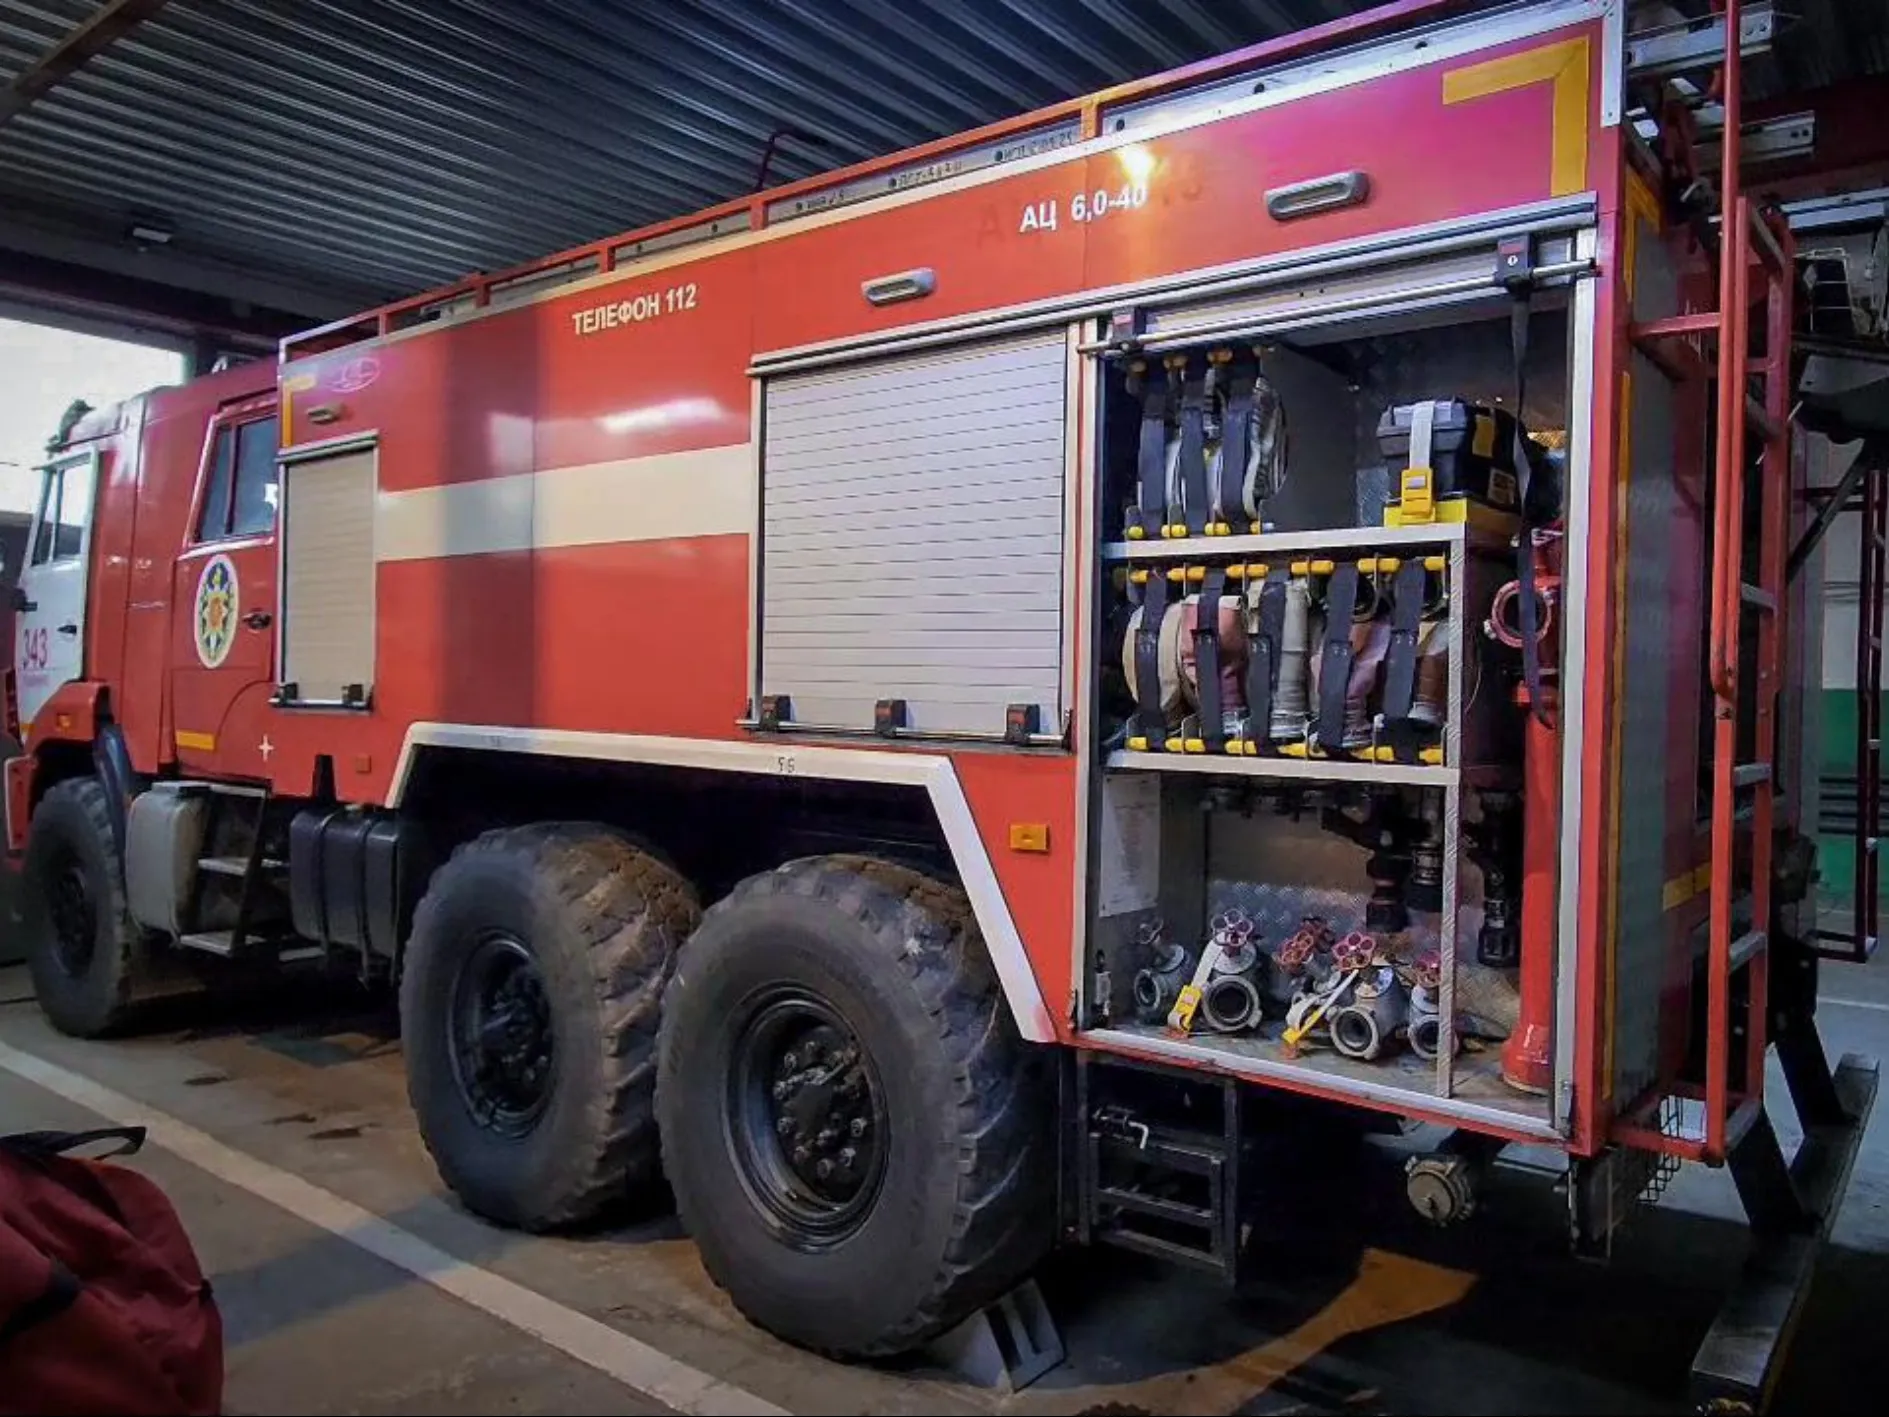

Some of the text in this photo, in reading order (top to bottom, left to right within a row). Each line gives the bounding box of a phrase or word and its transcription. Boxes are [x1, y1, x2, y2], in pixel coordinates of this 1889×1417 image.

[1018, 200, 1057, 233] АЦ
[1070, 183, 1148, 223] 6,0-40
[572, 283, 697, 335] ТЕЛЕФОН 112
[23, 627, 48, 669] 343
